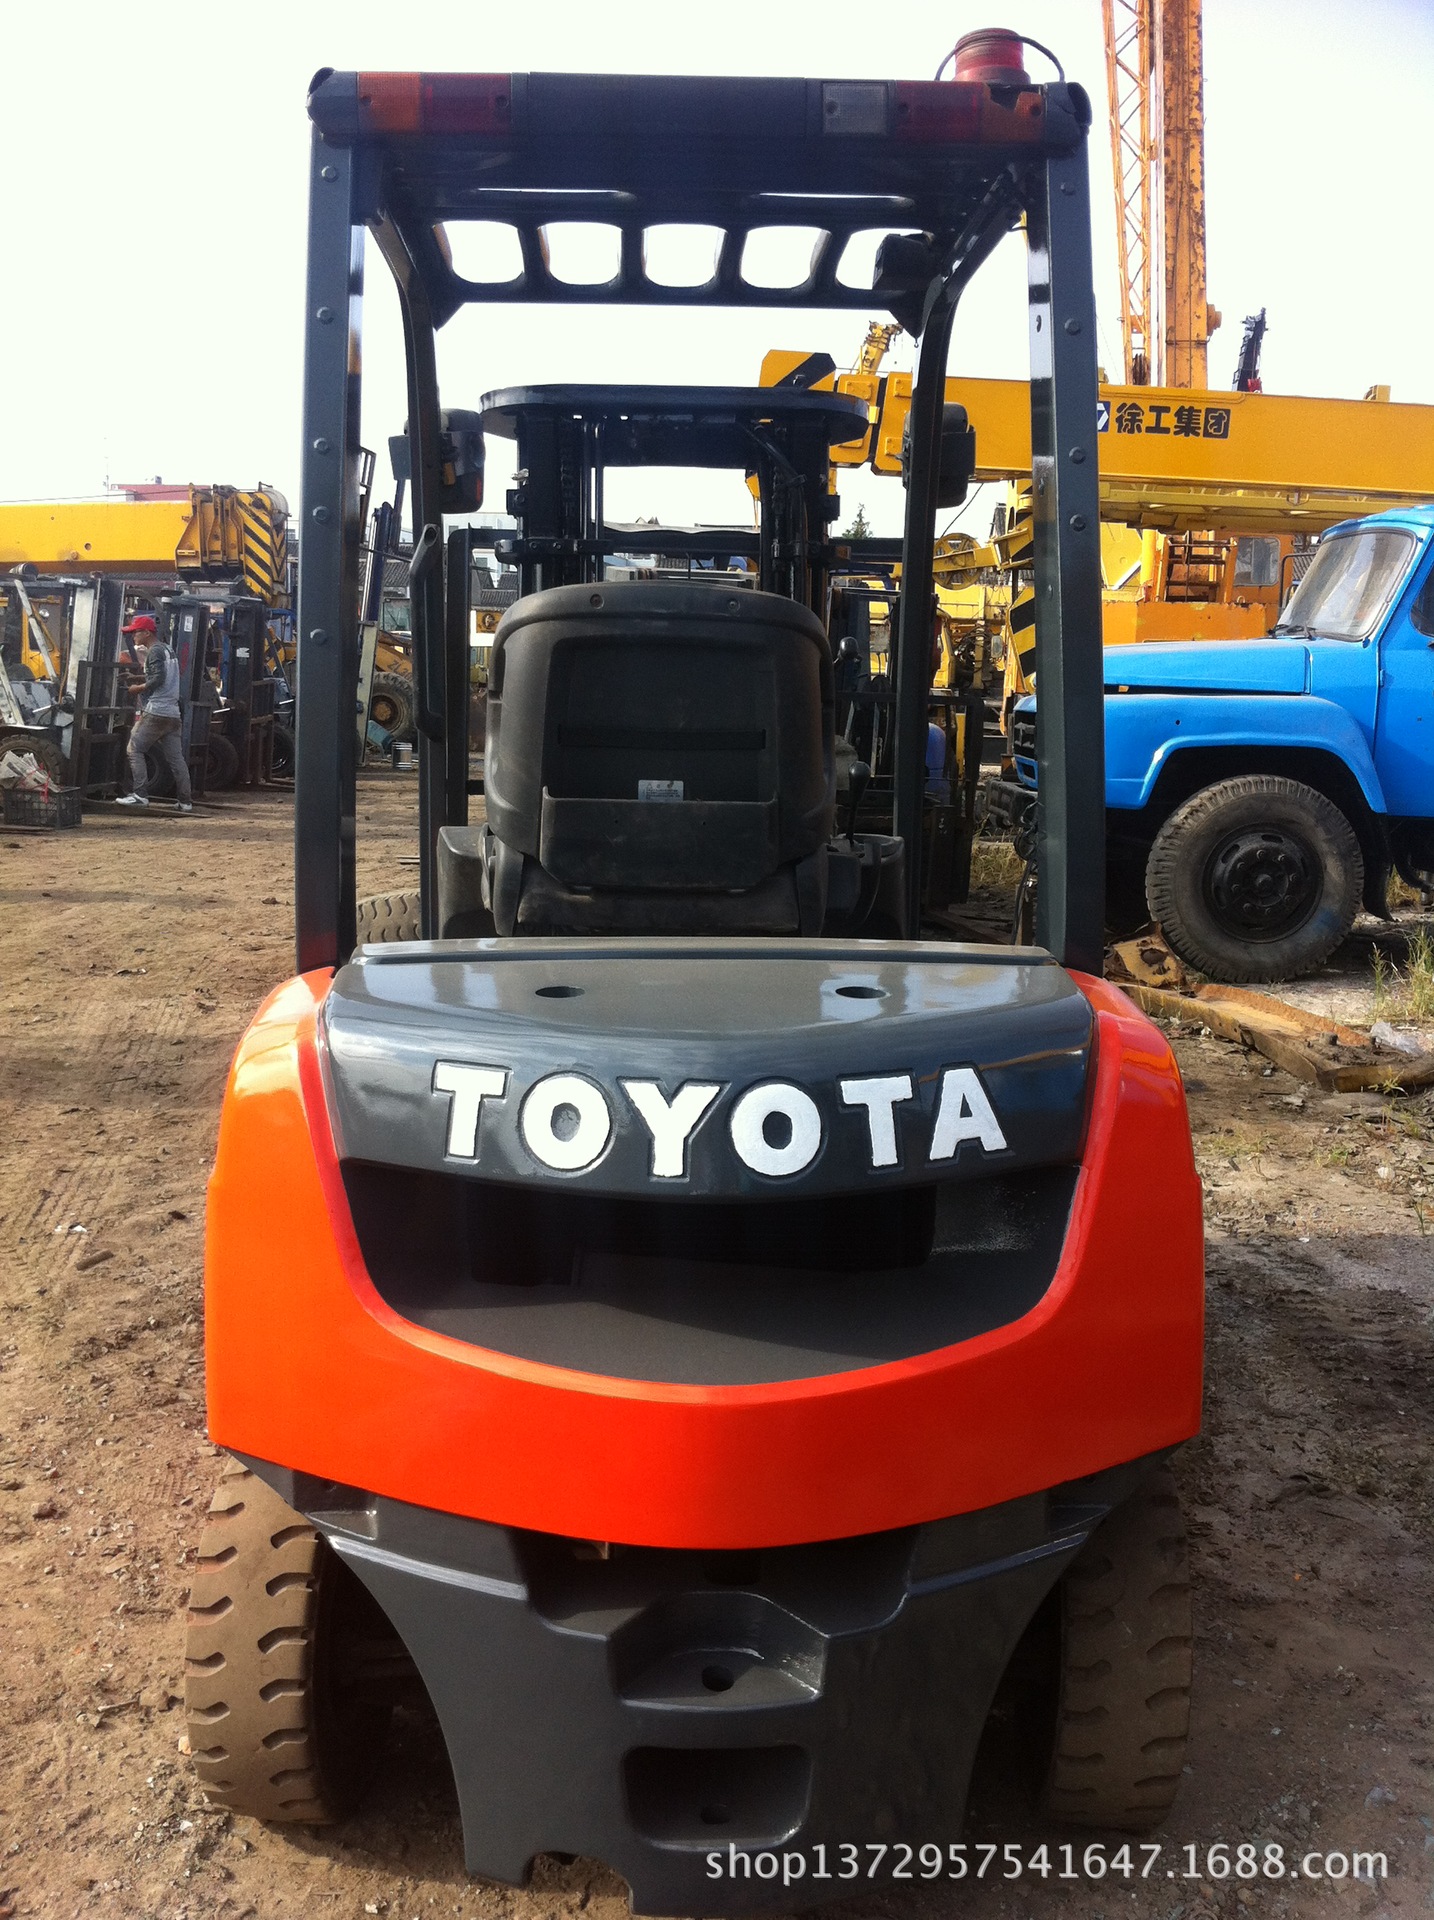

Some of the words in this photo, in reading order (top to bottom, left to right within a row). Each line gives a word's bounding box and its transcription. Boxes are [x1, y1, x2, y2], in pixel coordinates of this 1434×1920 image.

[1115, 402, 1231, 439] 徐工集团
[434, 1061, 1007, 1178] TOYOTA
